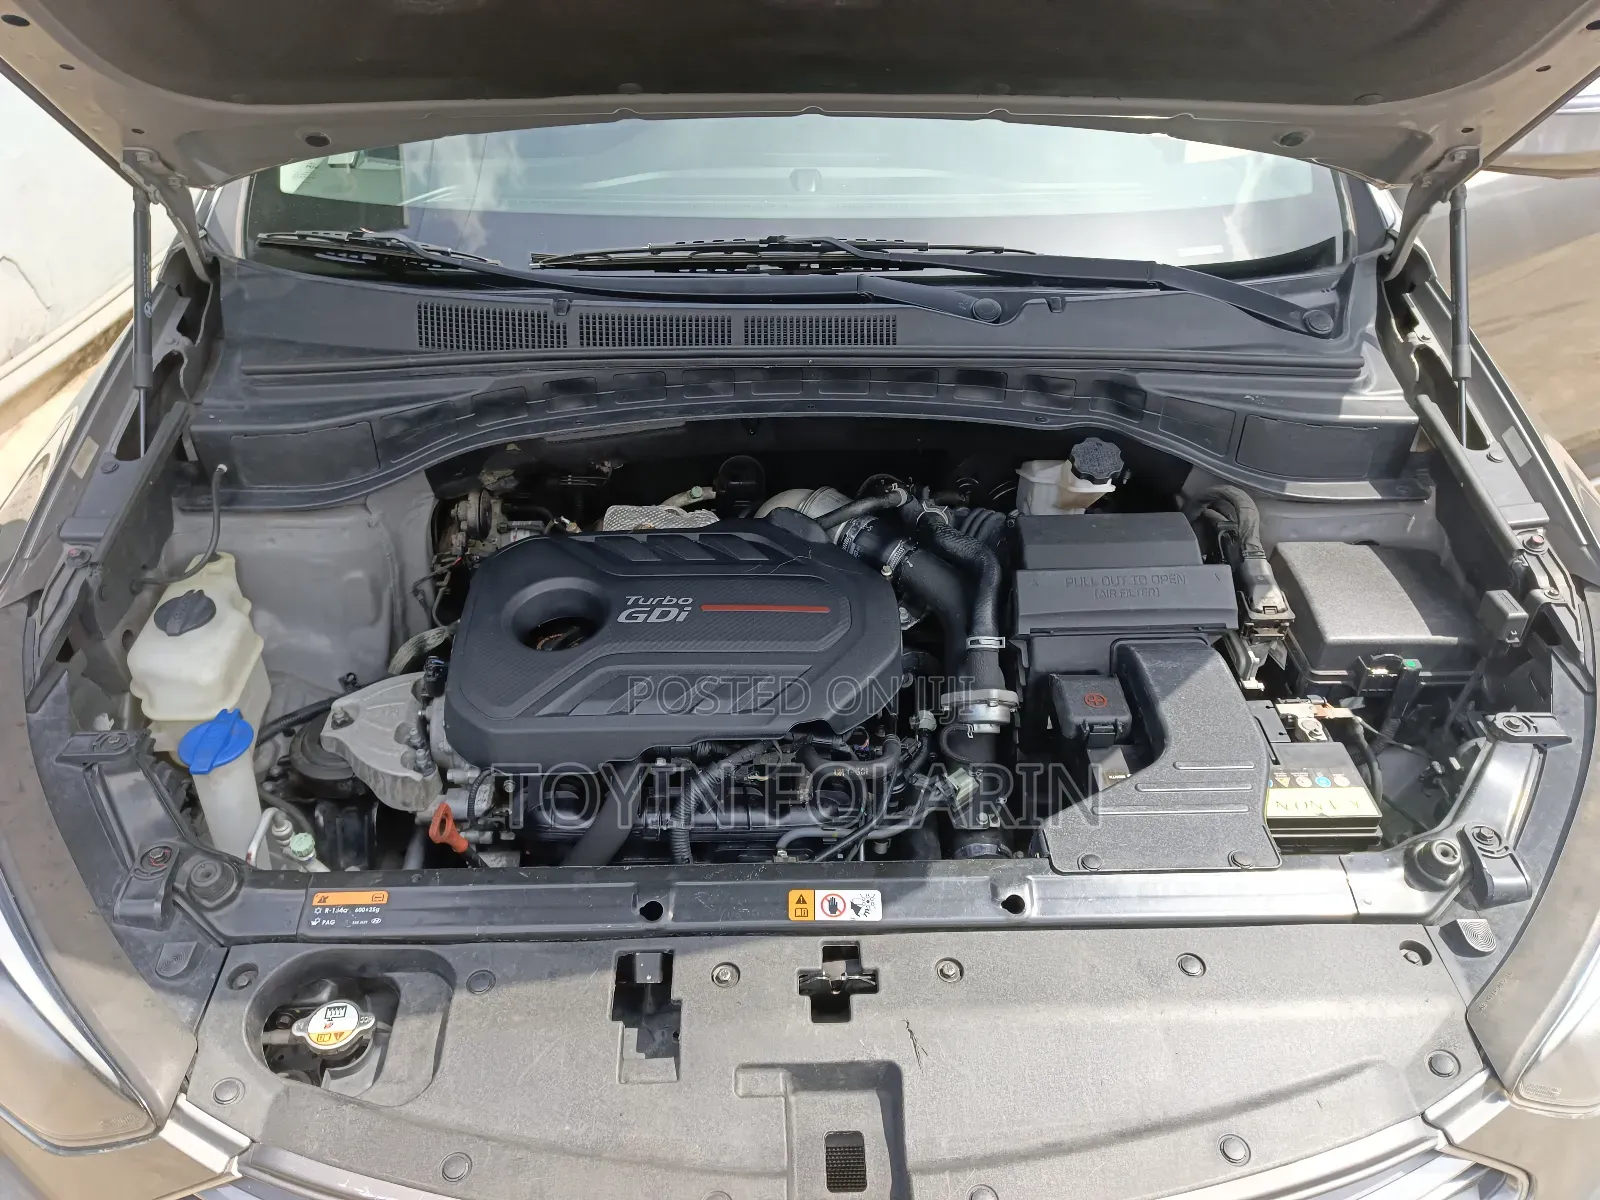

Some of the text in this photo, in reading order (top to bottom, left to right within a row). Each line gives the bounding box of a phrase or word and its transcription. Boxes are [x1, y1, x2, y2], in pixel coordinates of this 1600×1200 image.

[1065, 574, 1186, 588] PULL OUT TO OPEN
[625, 595, 694, 606] Turbo
[617, 606, 692, 623] GDi
